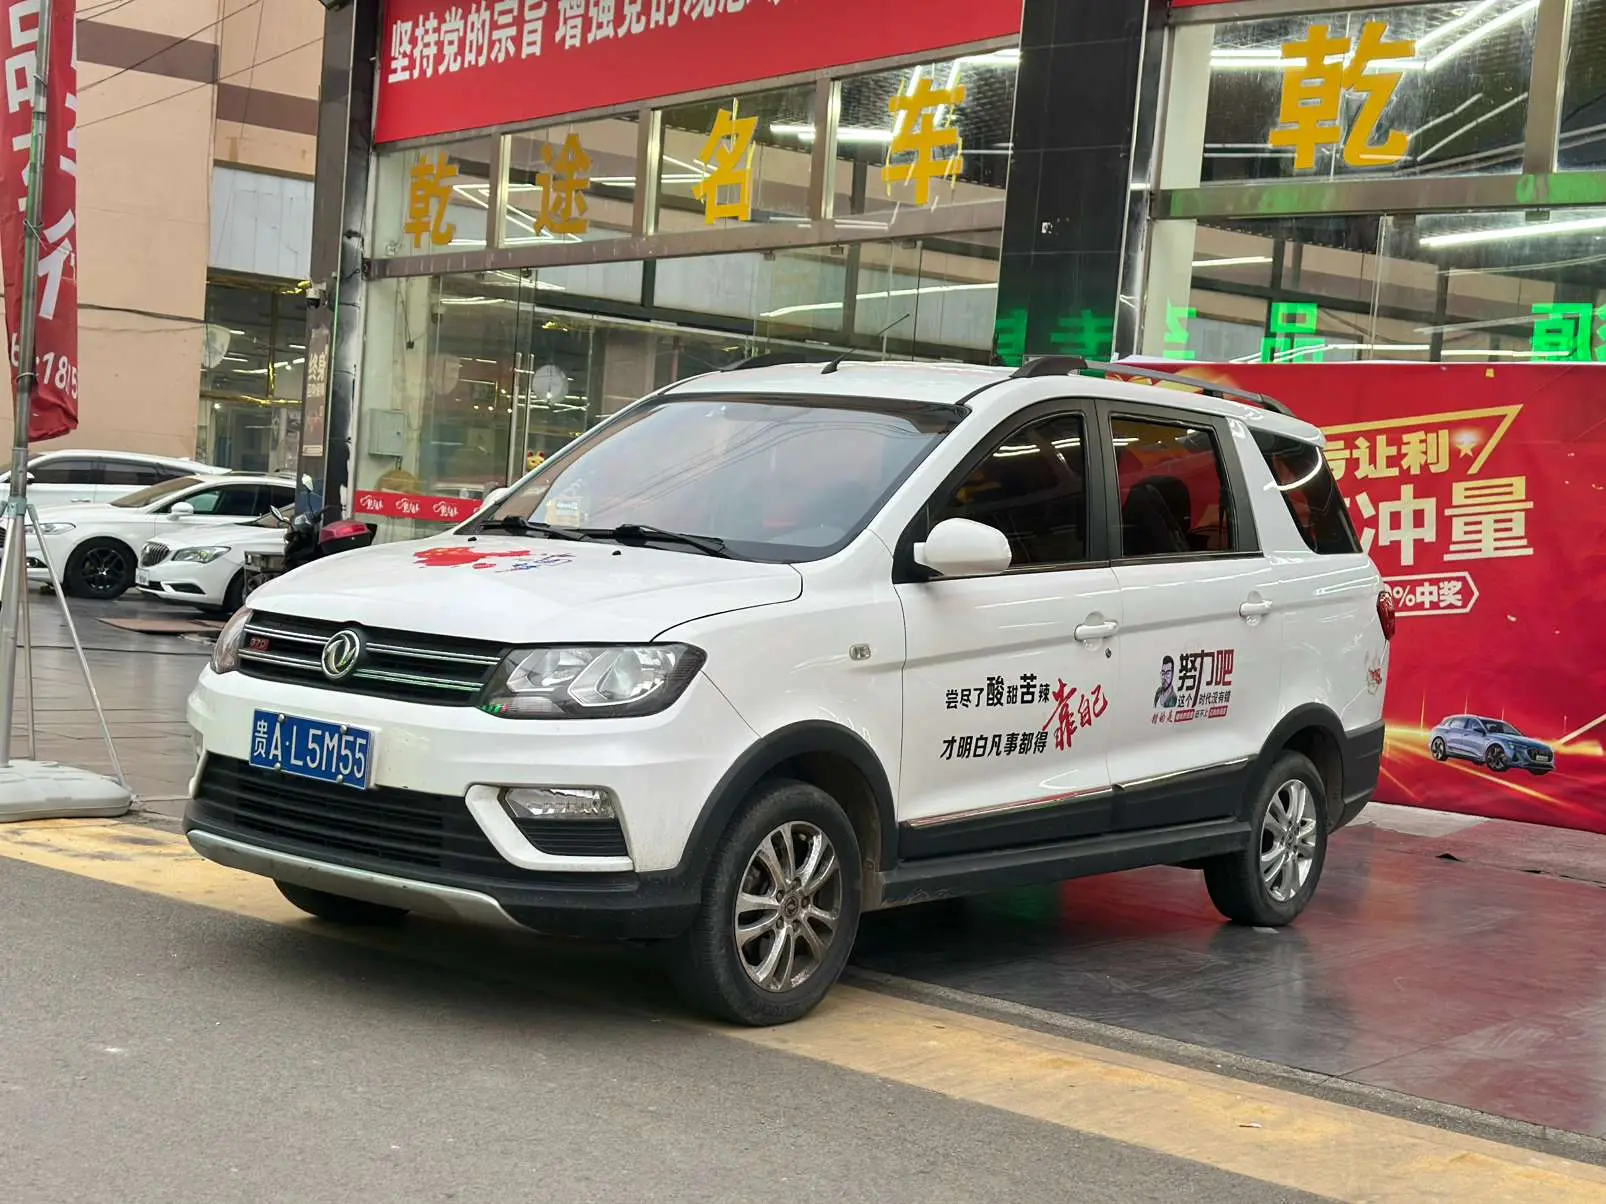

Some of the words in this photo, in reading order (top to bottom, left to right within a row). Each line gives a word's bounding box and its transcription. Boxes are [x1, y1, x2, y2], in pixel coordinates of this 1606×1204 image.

[388, 0, 547, 84] 坚持党的宗旨
[1268, 20, 1416, 169] 乾
[1345, 476, 1534, 566] 冲量
[1384, 580, 1463, 608] %中奖
[940, 731, 1048, 760] 才明白凡事都得
